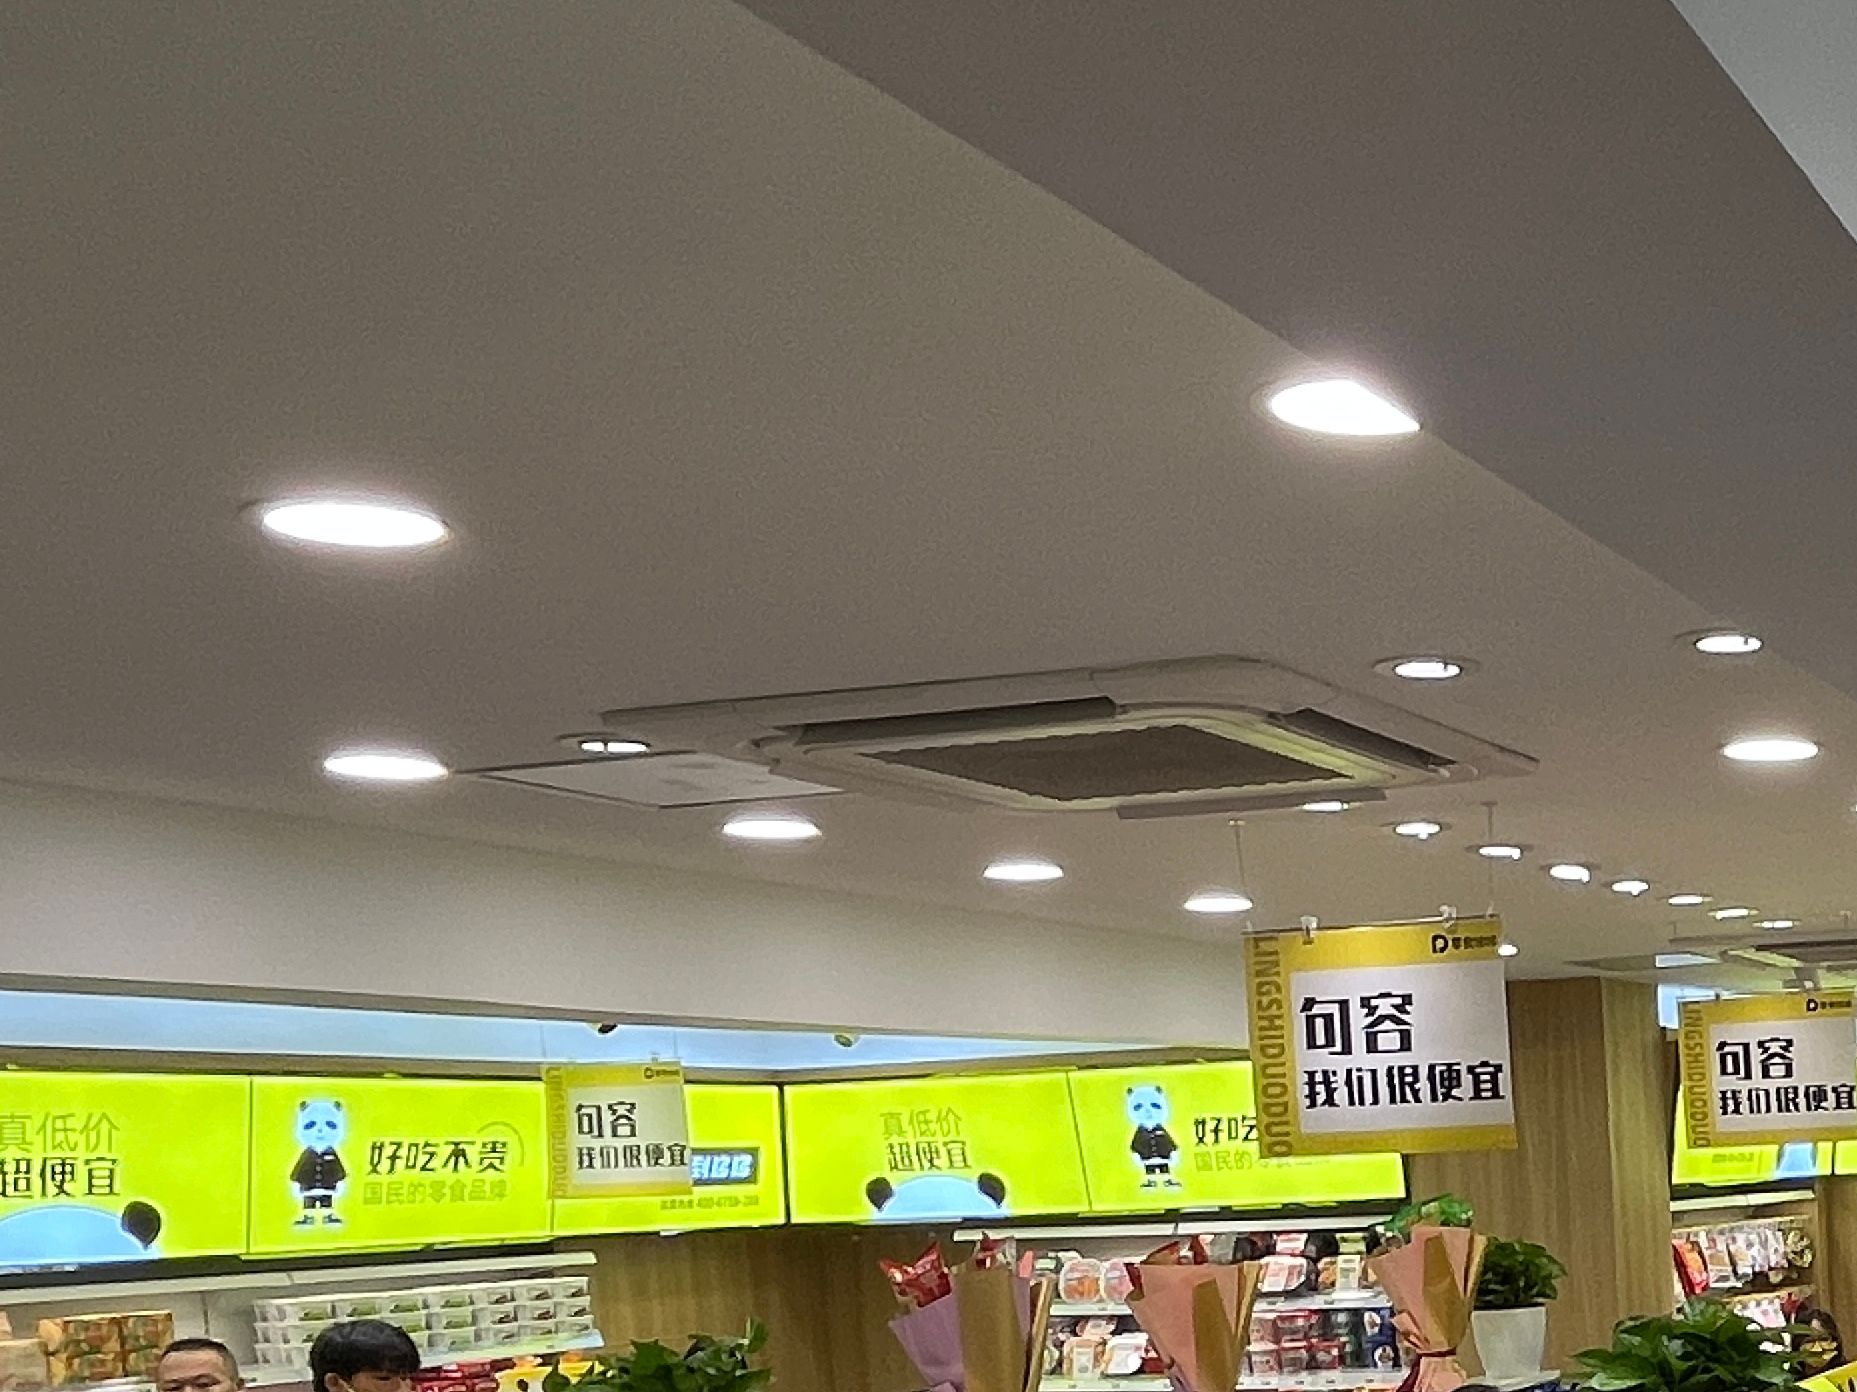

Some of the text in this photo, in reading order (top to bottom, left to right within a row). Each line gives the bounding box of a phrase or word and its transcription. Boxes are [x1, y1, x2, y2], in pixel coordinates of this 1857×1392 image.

[1300, 992, 1413, 1056] 句容
[1717, 1037, 1795, 1081] 句容
[1303, 1061, 1505, 1109] 我们很便宜
[1719, 1084, 1857, 1116] 我们很便宜
[0, 1112, 120, 1154] 真低价
[575, 1101, 638, 1139] 句容
[880, 1108, 963, 1138] 真低价
[368, 1140, 508, 1176] 好吃不贵
[577, 1143, 688, 1170] 我们很便宜
[887, 1140, 972, 1172] 超便宜
[0, 1157, 121, 1198] 超便宜
